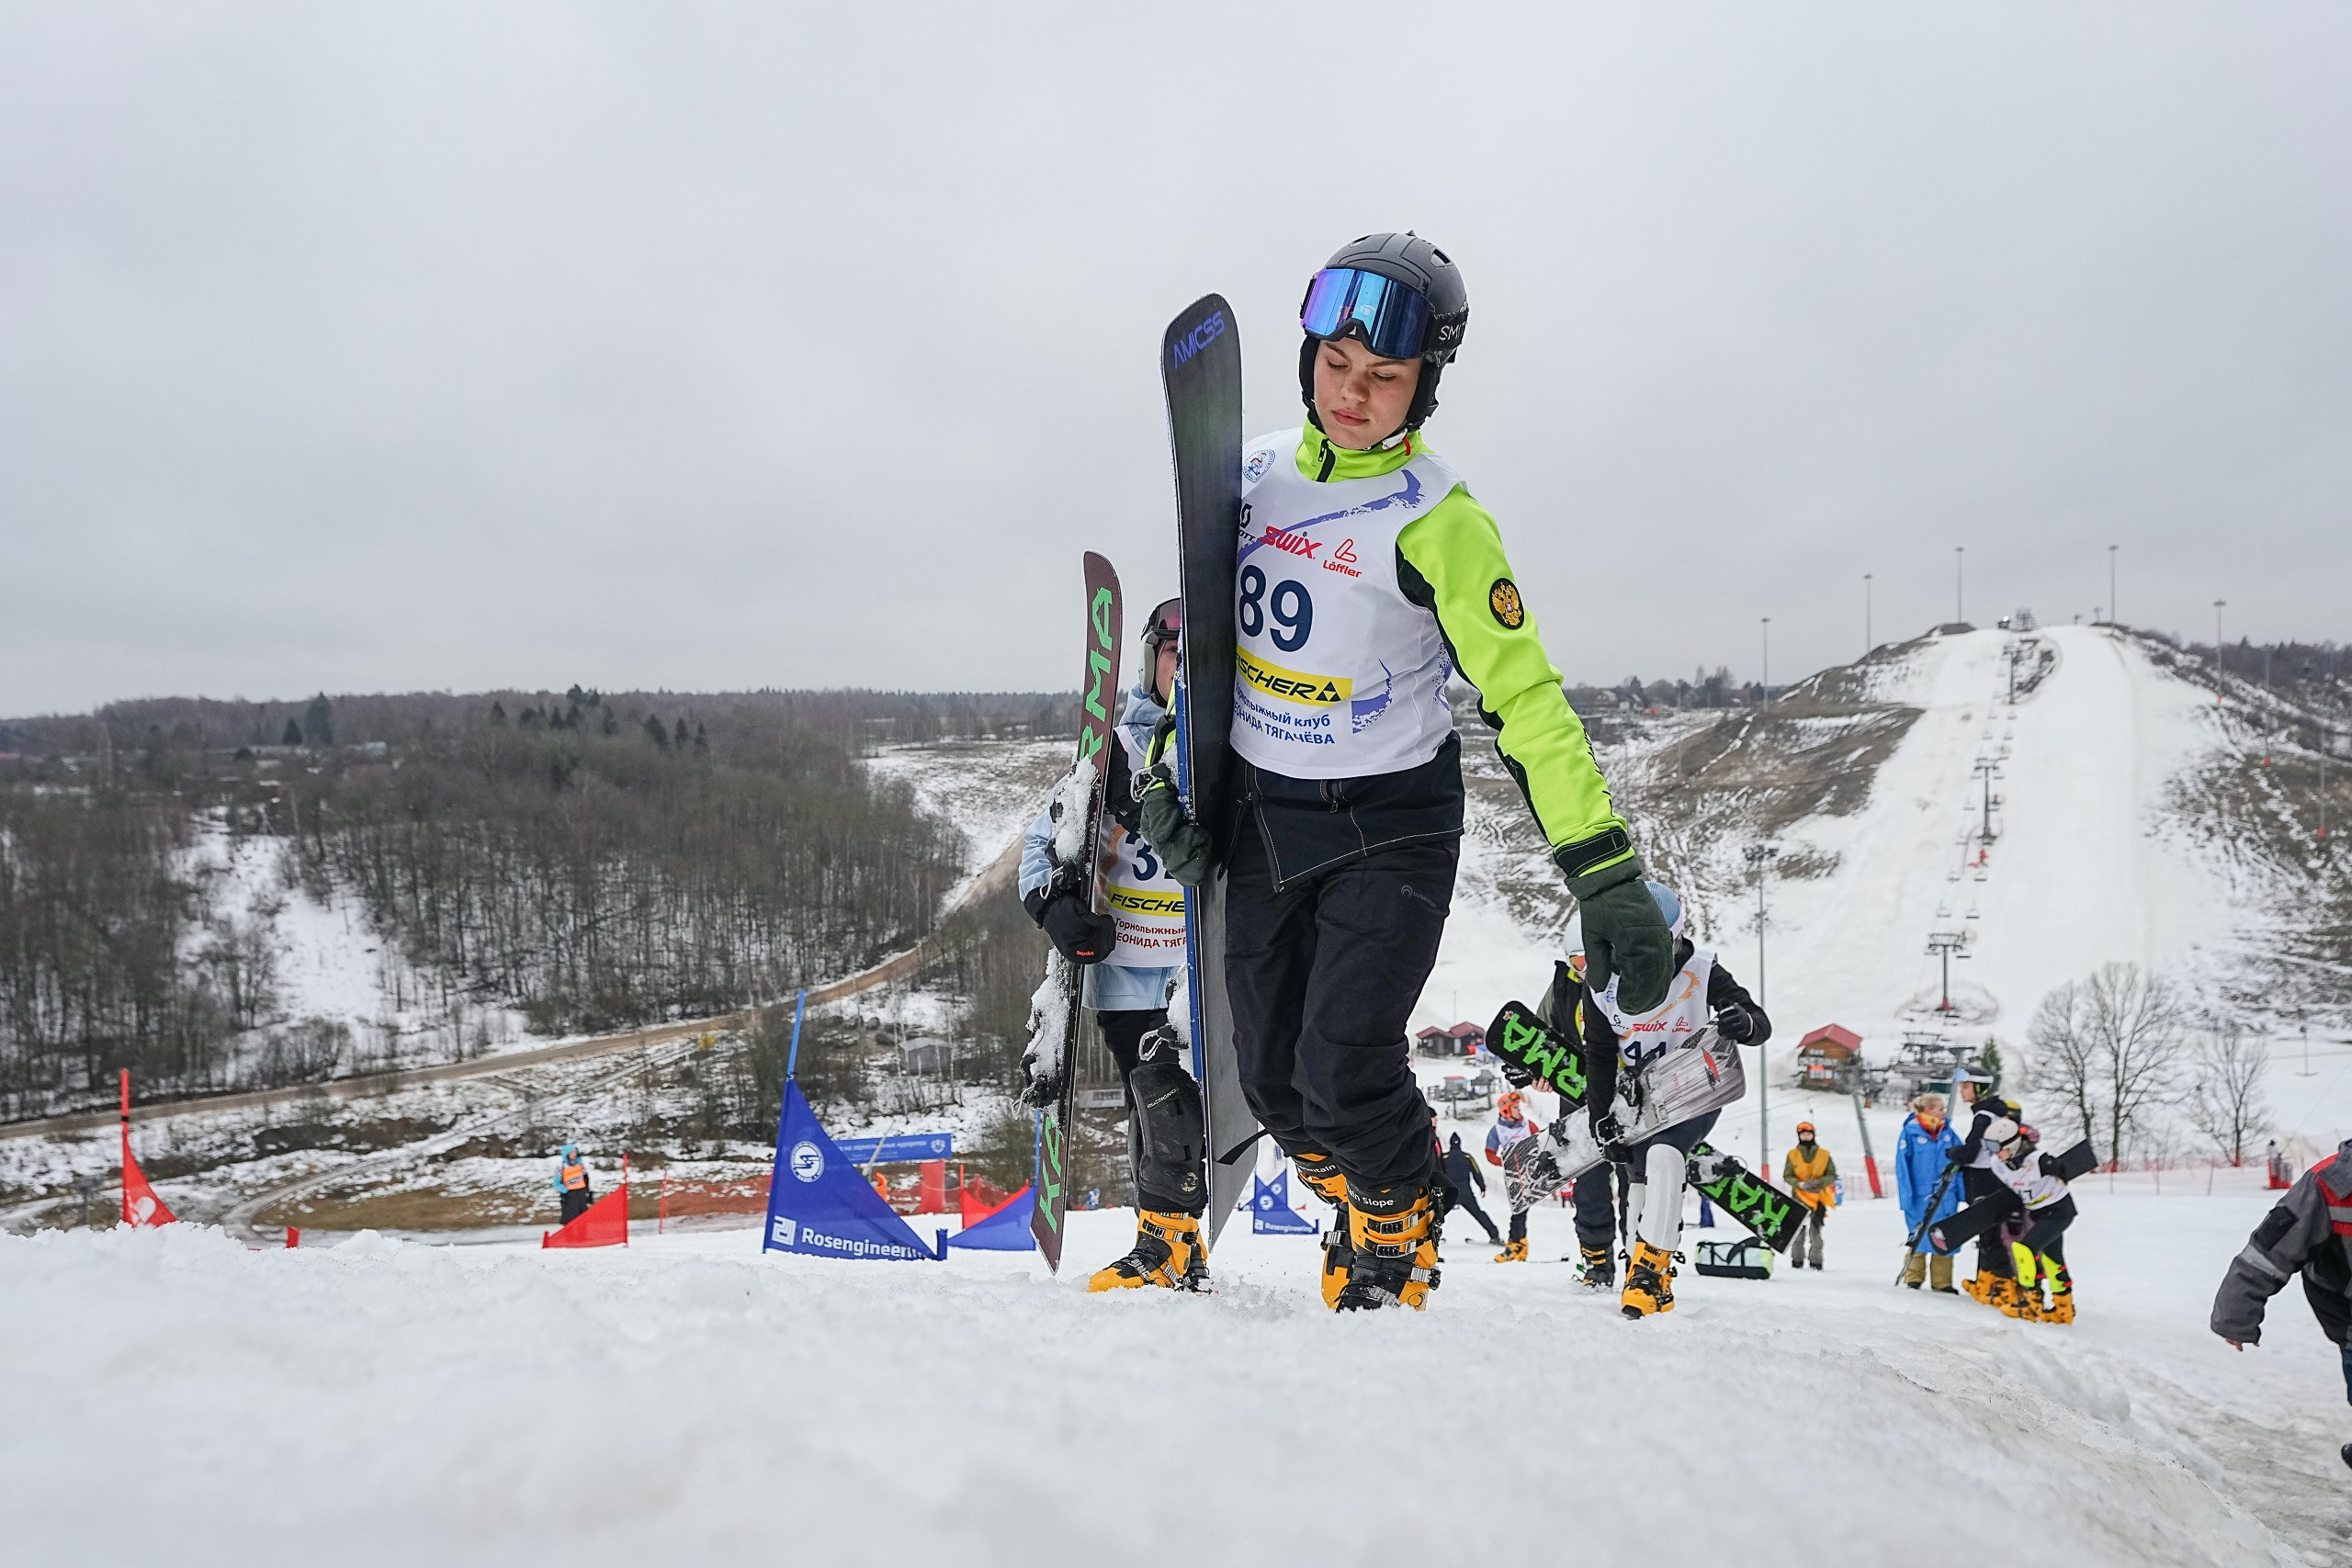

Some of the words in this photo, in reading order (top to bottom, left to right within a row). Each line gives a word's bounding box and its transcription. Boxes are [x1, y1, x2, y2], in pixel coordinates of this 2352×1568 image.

[1239, 529, 1256, 542] OTT
[1322, 559, 1363, 578] Löffler
[1240, 565, 1314, 652] 89
[1234, 701, 1263, 732] ЕОНИДА
[1264, 723, 1335, 744] ТЯГАЧЁВА
[1294, 714, 1330, 729] клуб
[1110, 893, 1185, 912] FISCHE
[1115, 931, 1160, 948] ЕОНИДА
[1362, 1197, 1394, 1208] Slope
[801, 1227, 923, 1258] Rosengineeri
